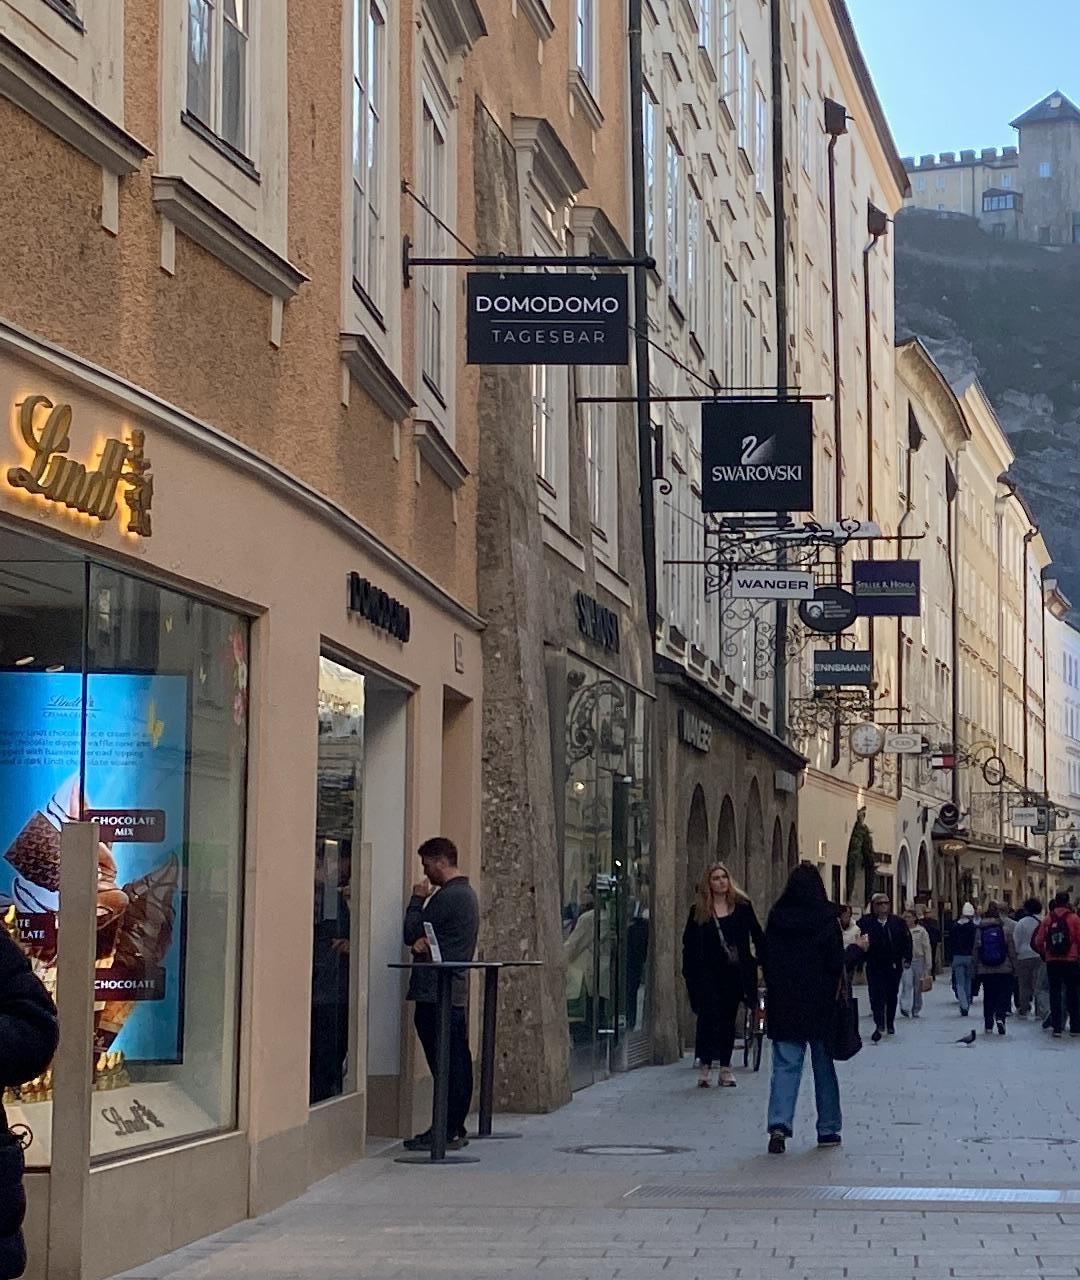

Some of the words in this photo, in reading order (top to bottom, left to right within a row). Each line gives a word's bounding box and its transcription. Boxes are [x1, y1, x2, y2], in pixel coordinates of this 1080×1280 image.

[475, 295, 619, 313] DOMODOMO
[491, 328, 605, 344] TAGESBAR
[7, 395, 129, 521] Lindt
[711, 464, 803, 482] SWAROVSKI
[737, 578, 809, 591] WANGER
[91, 816, 156, 826] CHOCOLATE
[114, 828, 134, 837] MIX
[94, 979, 155, 990] CHOCOLATE
